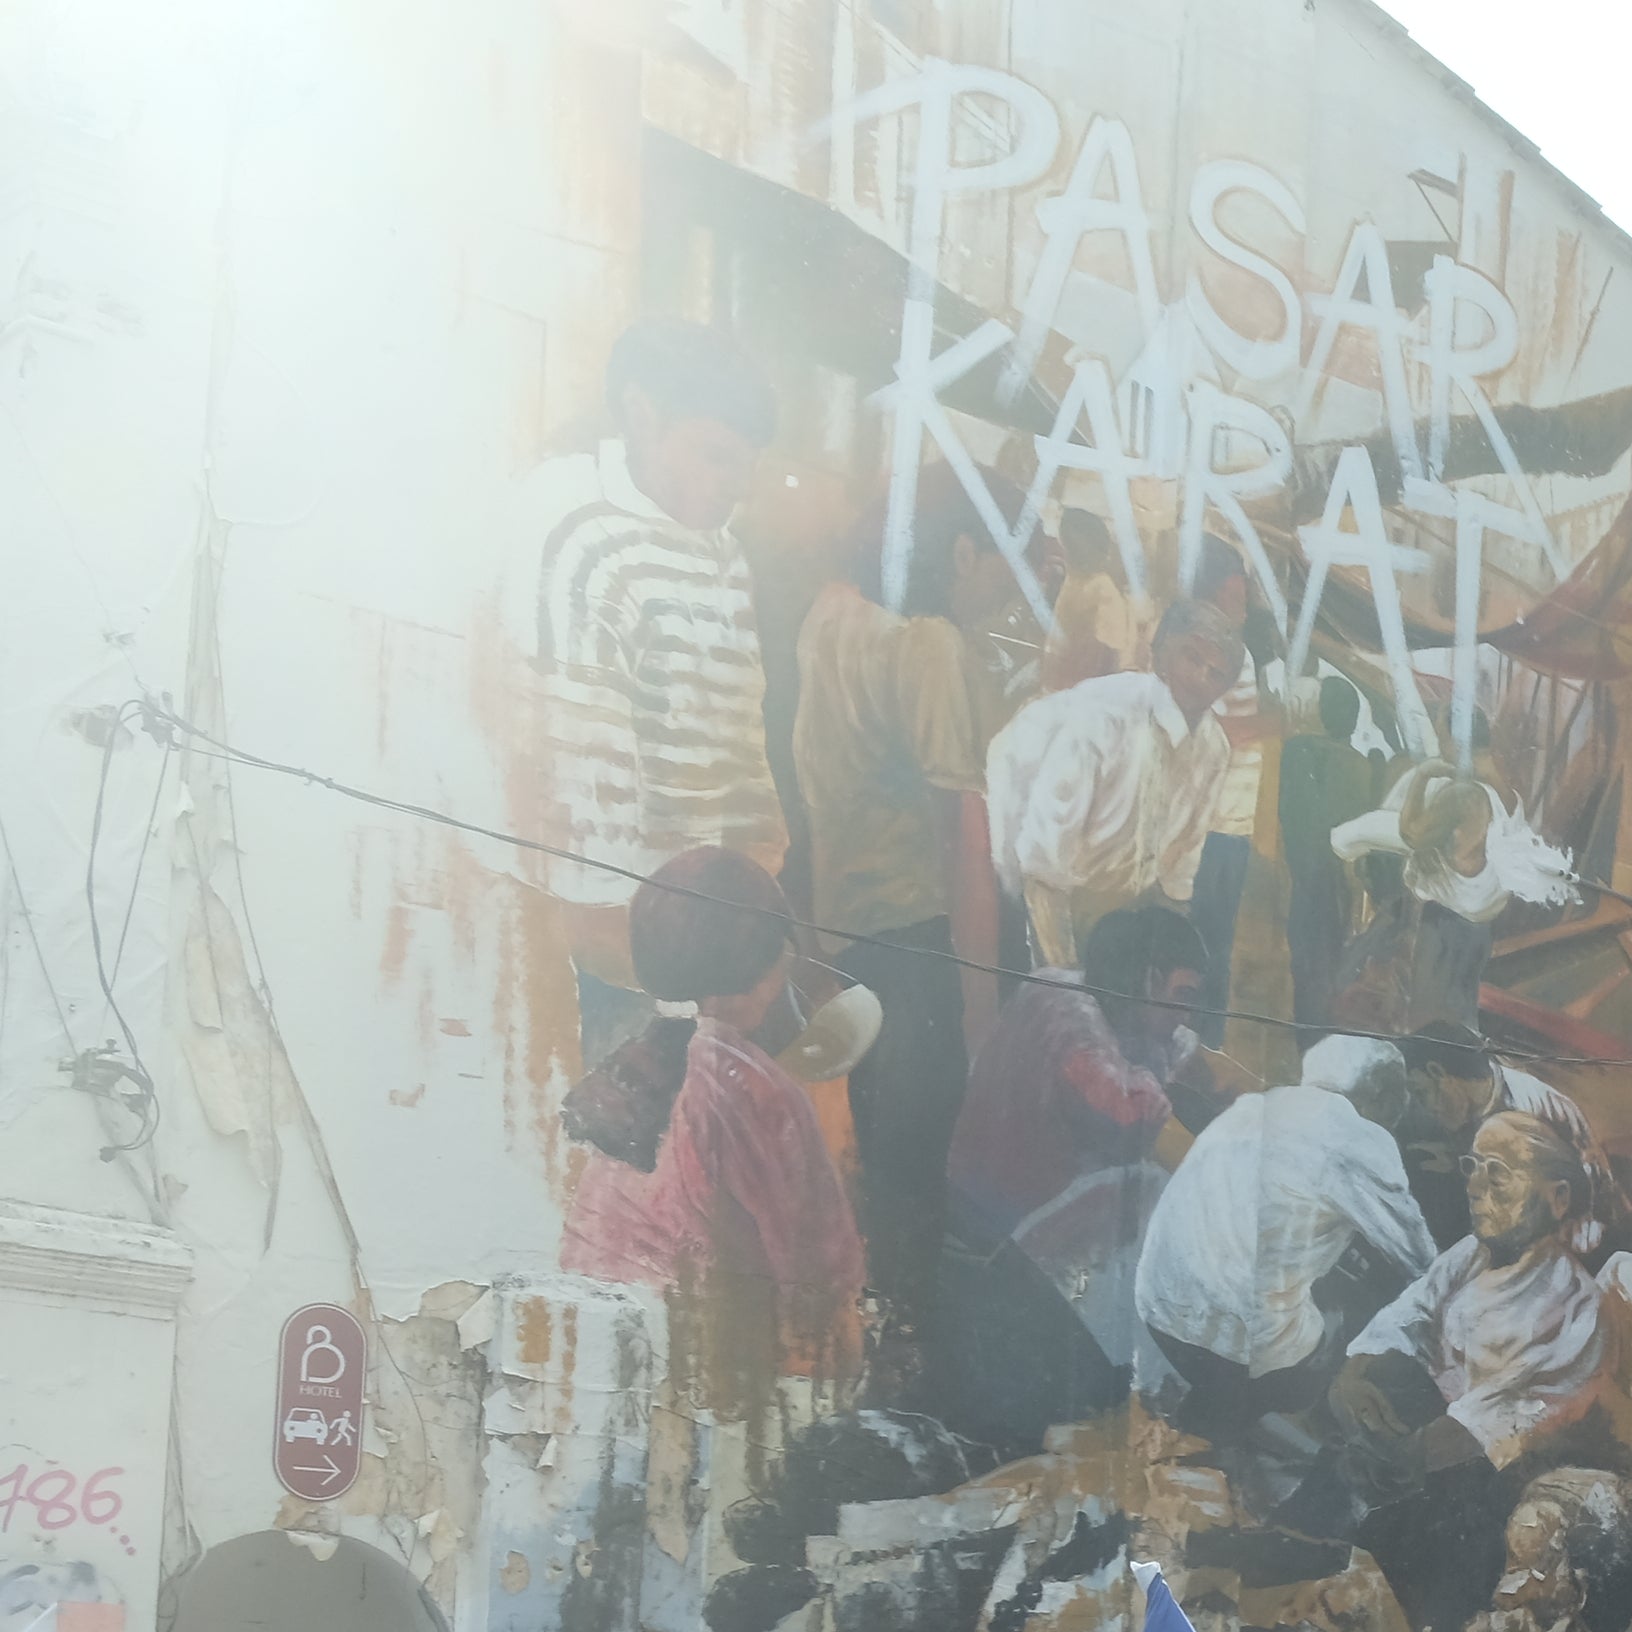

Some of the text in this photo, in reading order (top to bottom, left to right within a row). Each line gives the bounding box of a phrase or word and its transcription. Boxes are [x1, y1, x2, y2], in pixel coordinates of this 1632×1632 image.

[815, 57, 1574, 582] PASAR
[870, 300, 1550, 778] KARAT
[298, 1384, 342, 1398] HOTEL
